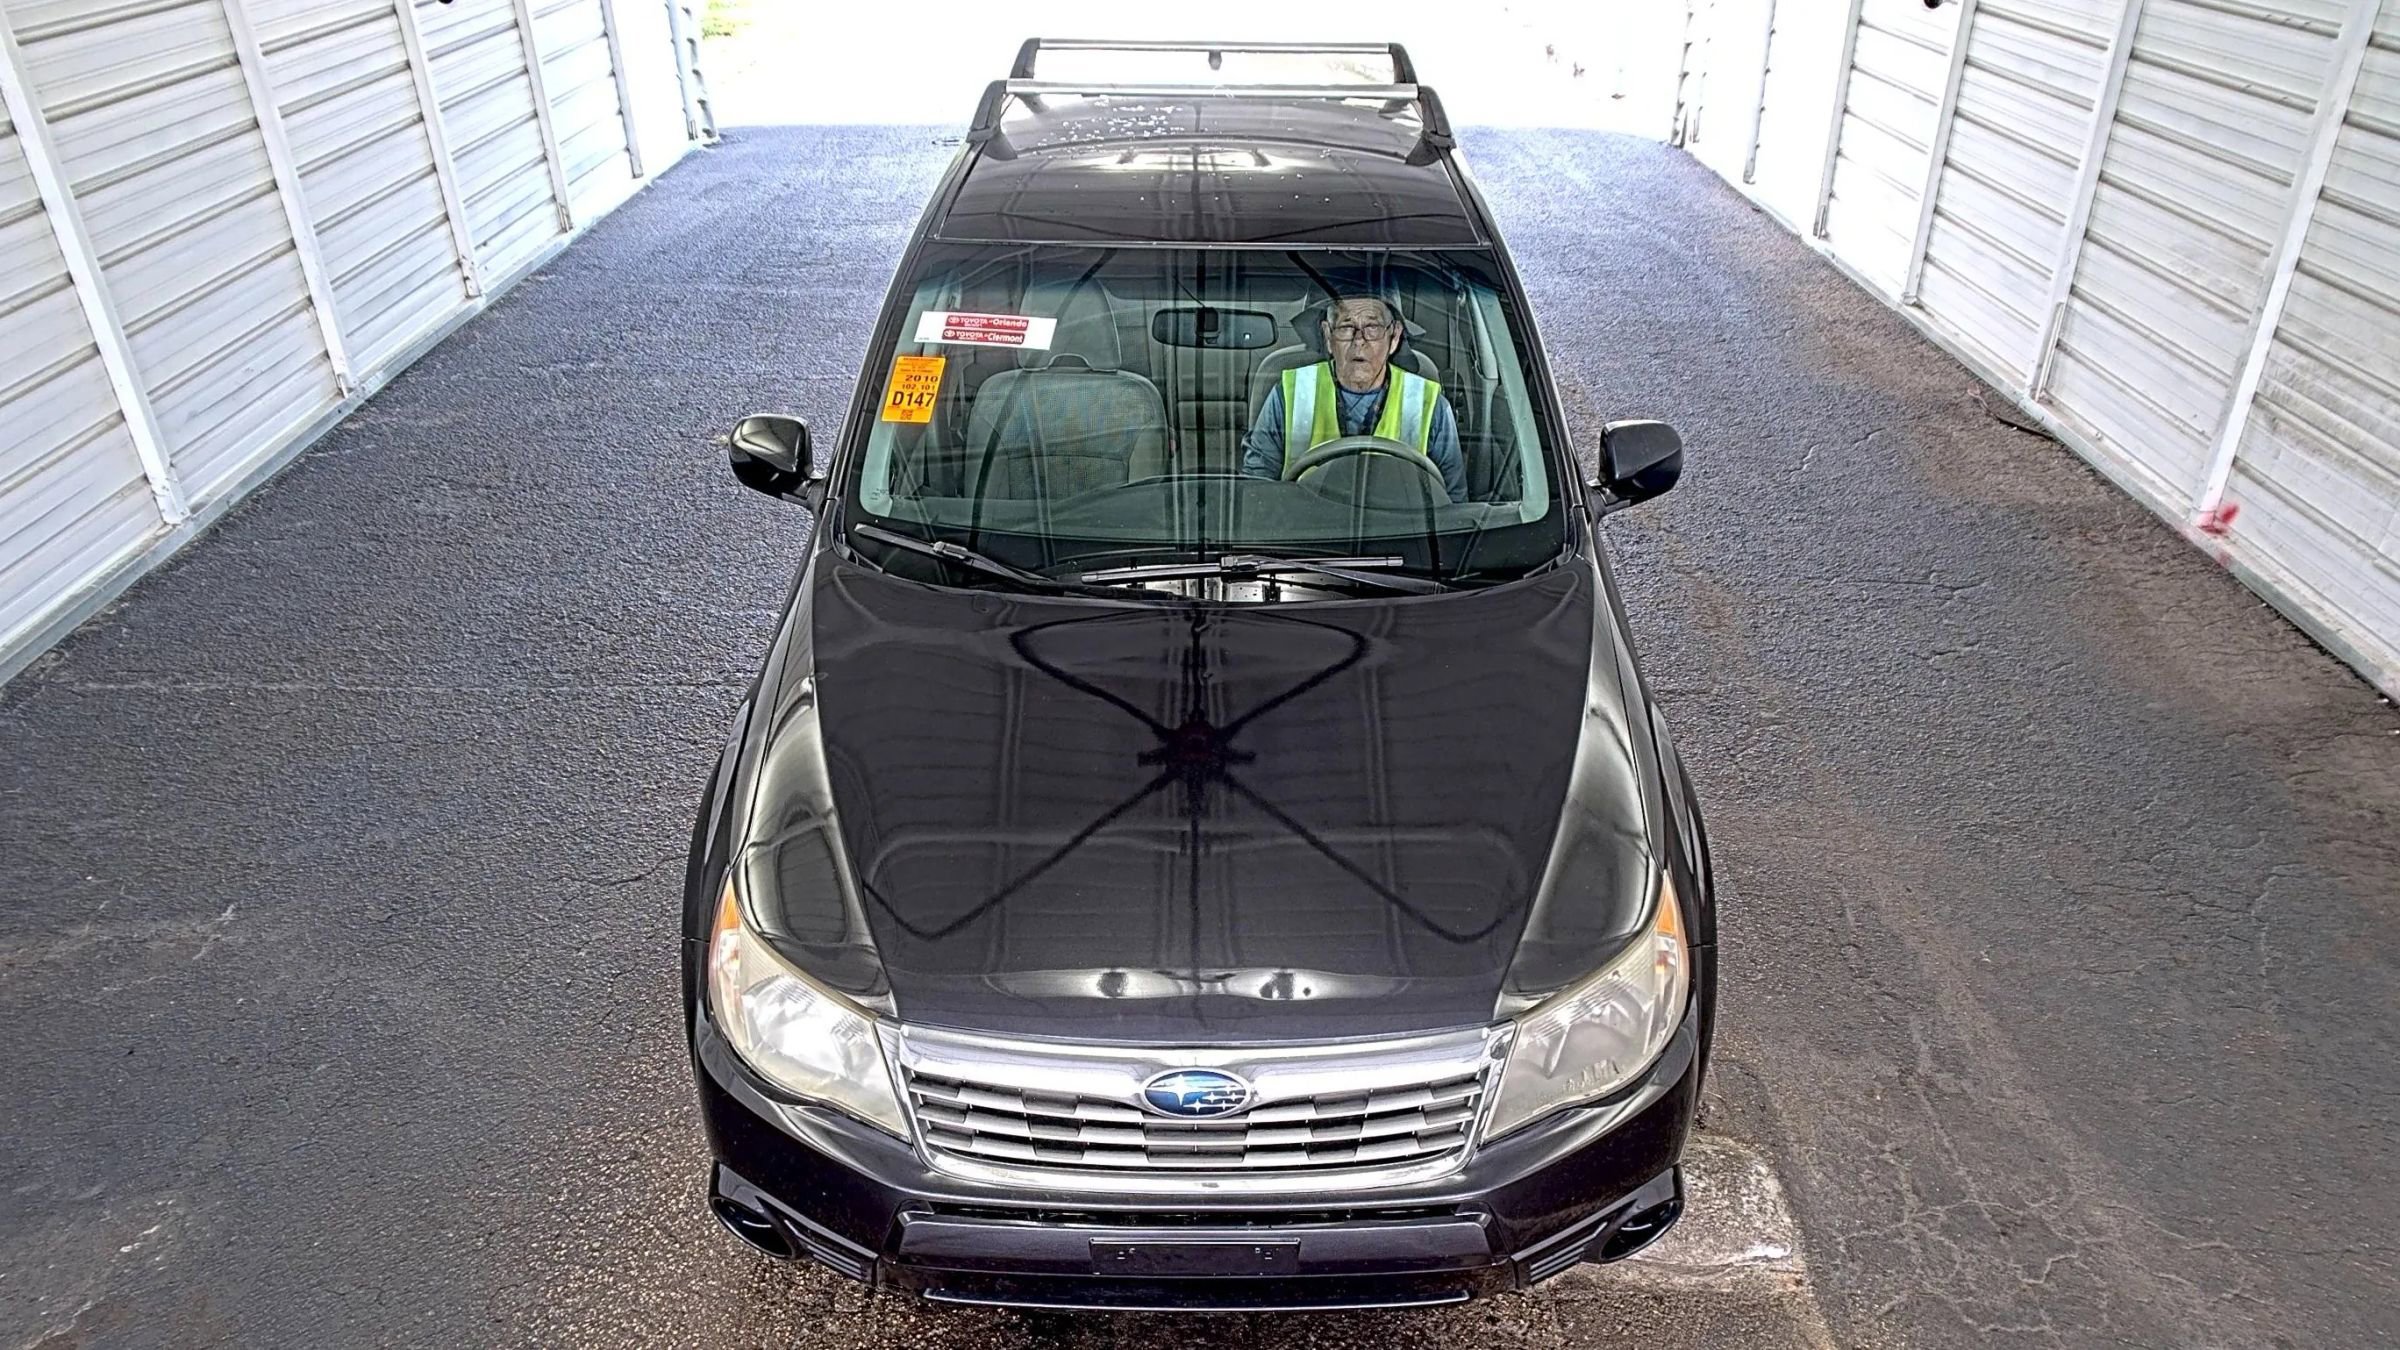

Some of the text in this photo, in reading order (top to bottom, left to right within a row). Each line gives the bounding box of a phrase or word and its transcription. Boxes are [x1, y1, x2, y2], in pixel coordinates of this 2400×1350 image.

[960, 317, 988, 325] TOYOTA
[993, 318, 1027, 327] Orlando
[988, 332, 1023, 343] Clermont
[905, 374, 938, 383] 2010
[892, 391, 935, 407] D147
